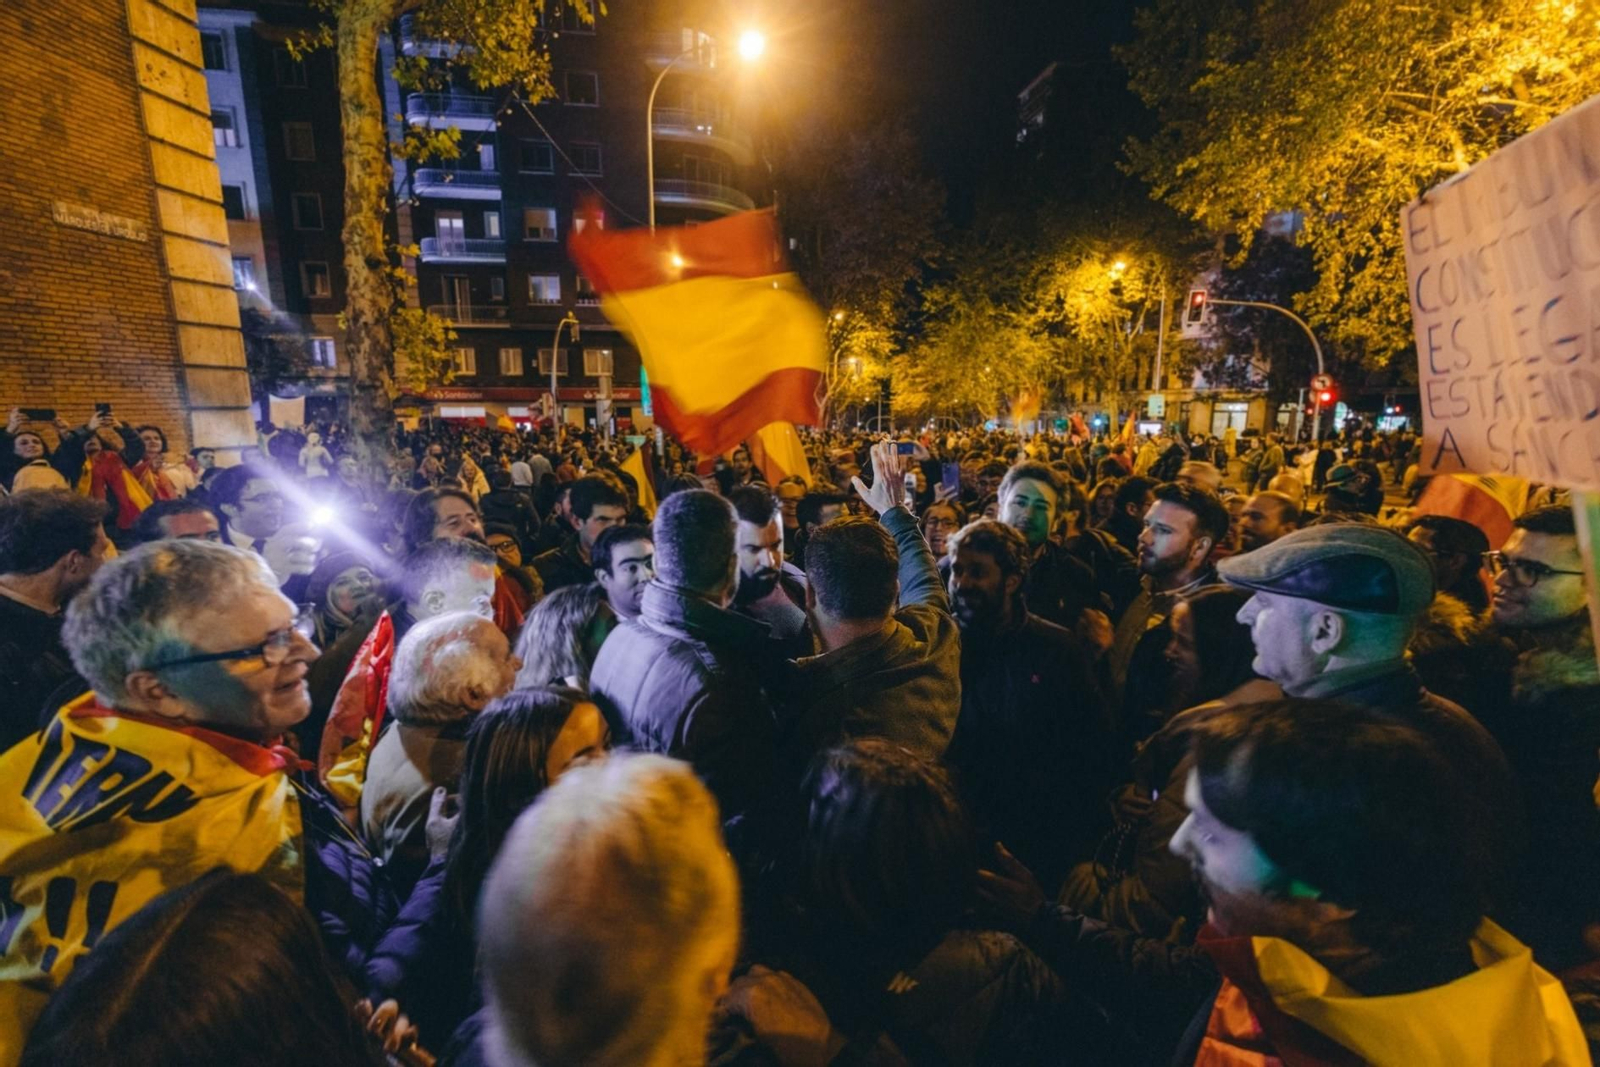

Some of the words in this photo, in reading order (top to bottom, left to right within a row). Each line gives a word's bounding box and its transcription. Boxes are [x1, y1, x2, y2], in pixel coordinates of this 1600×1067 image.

[1428, 318, 1472, 375] ES
[444, 391, 482, 399] Santander
[1431, 427, 1466, 470] A
